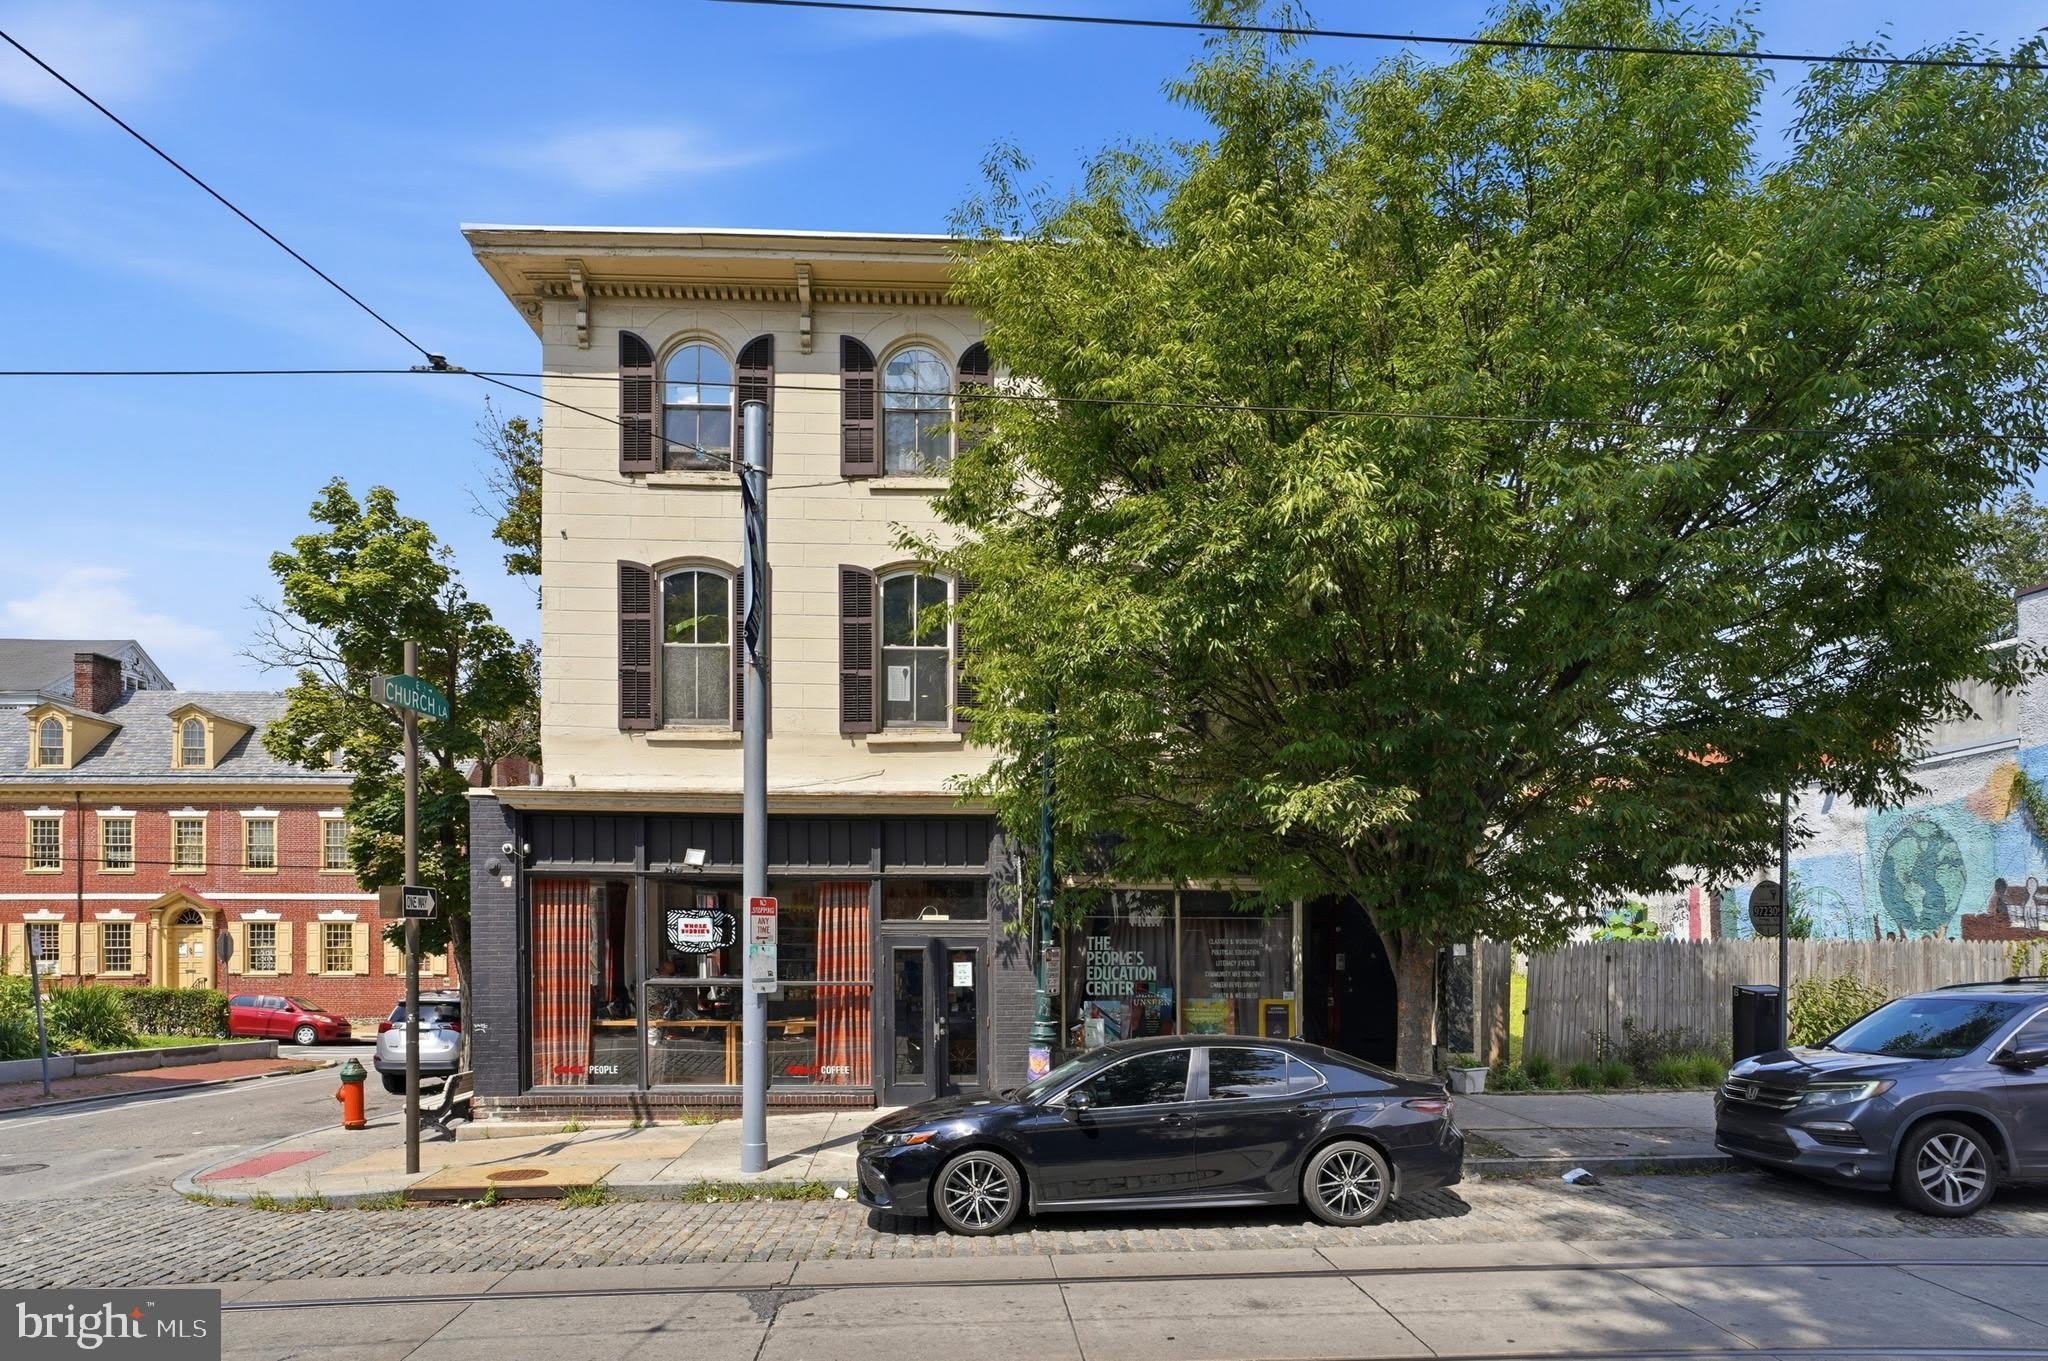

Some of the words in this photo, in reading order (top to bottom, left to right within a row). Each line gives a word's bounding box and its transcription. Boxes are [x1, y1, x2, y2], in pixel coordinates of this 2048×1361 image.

[386, 682, 435, 715] CHURCH
[438, 705, 448, 718] LA
[406, 896, 417, 909] ONE
[418, 896, 428, 909] WAY
[752, 906, 775, 914] STOPPING
[757, 917, 769, 925] ANY
[757, 926, 770, 934] TIME
[1086, 935, 1111, 951] THE
[1086, 951, 1144, 966] PEOPLE'S
[1086, 966, 1157, 981] EDUCATION
[1085, 981, 1134, 996] CENTER
[589, 1065, 619, 1075] PEOPLE
[820, 1065, 850, 1075] COFFEE
